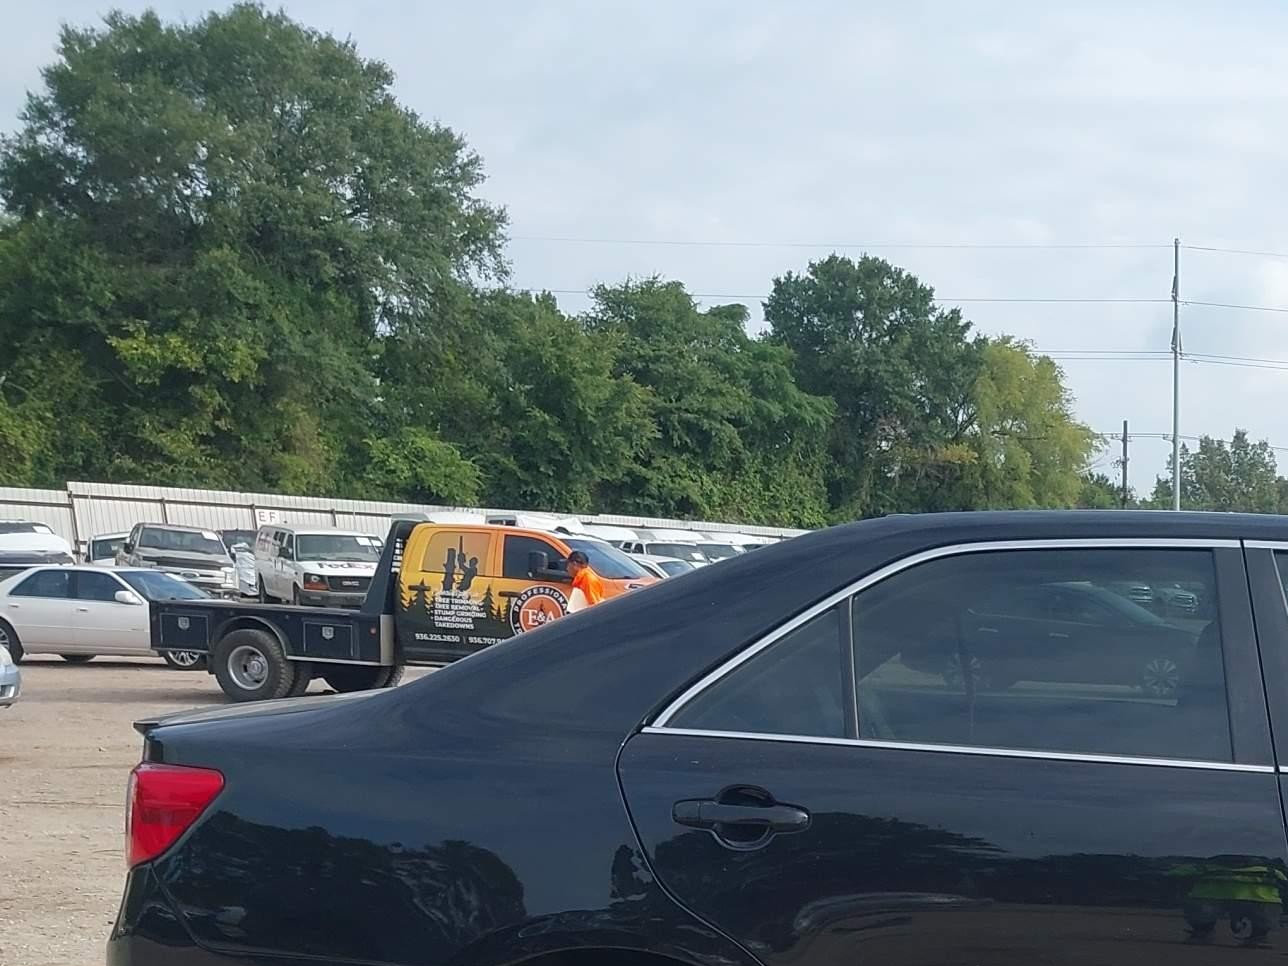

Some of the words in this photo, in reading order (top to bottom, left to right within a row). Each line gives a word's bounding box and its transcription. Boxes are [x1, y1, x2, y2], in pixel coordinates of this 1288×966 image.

[434, 615, 473, 623] DANGEROUS
[523, 609, 555, 626] E&A
[434, 621, 474, 630] TAKEDOWNS
